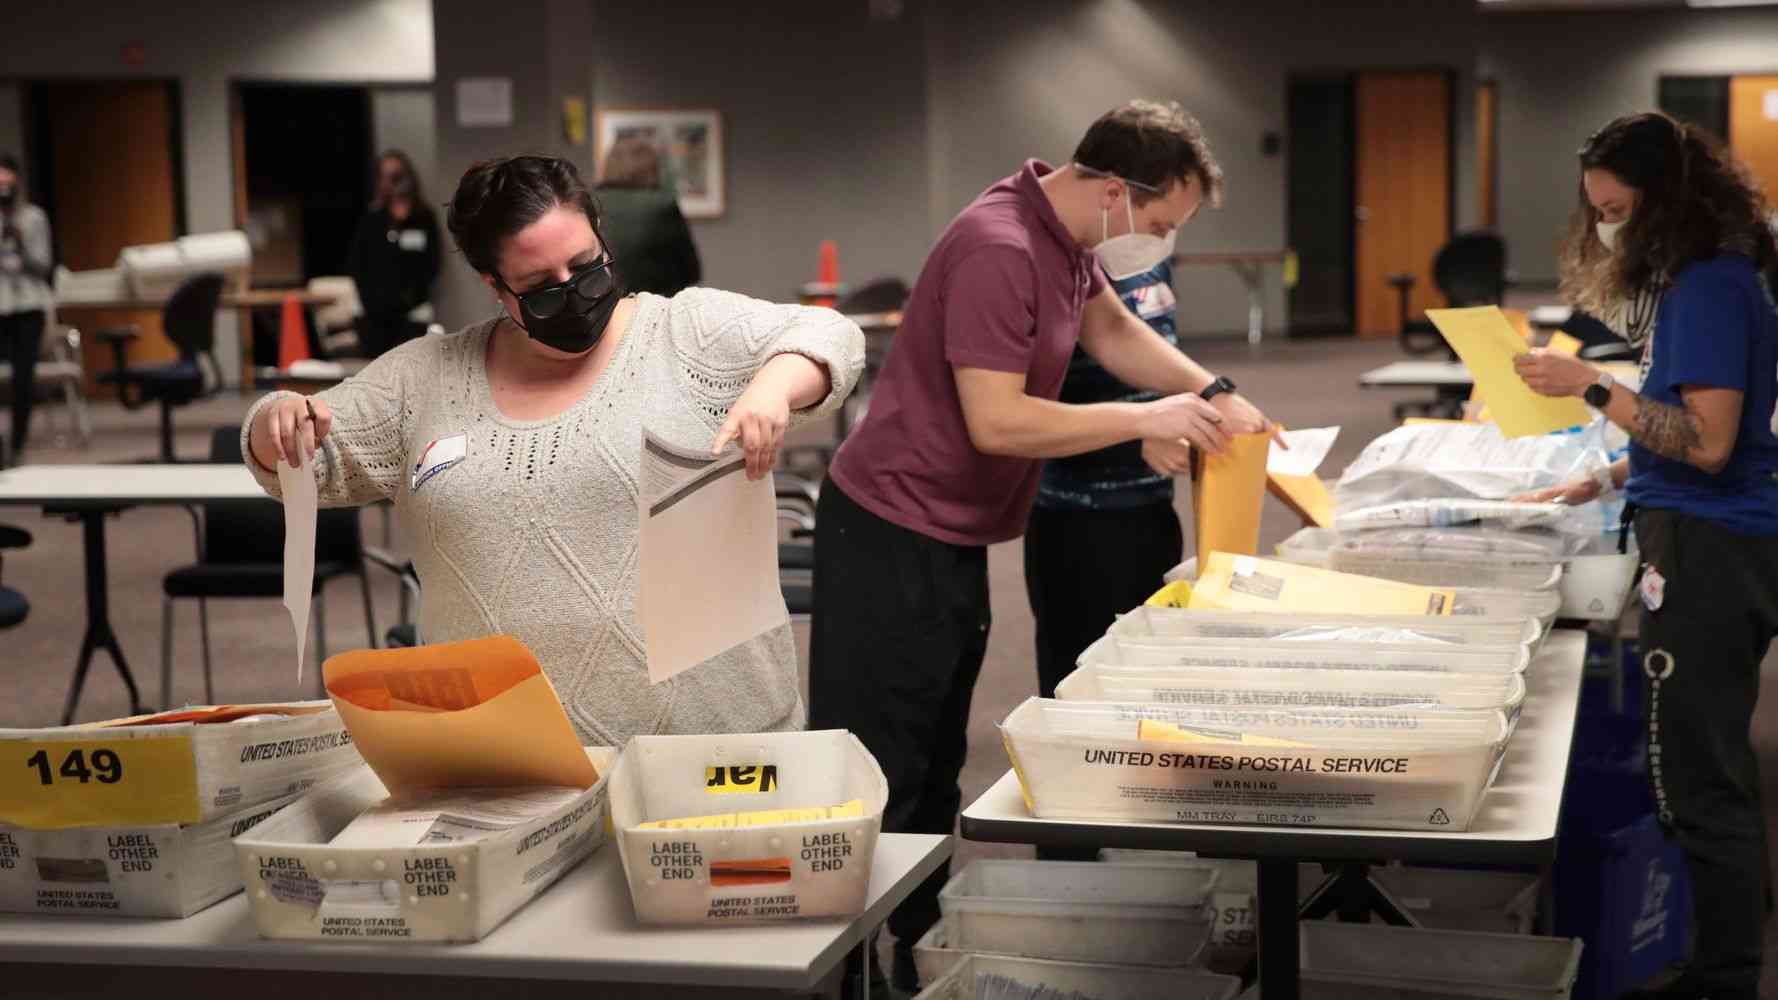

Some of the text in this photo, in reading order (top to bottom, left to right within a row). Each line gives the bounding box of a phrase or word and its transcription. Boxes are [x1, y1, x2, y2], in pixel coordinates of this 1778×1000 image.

[241, 743, 278, 763] UNITED
[276, 737, 310, 760] STATES
[27, 749, 122, 785] 149
[1085, 749, 1409, 774] UNITED STATES POSTAL SERVICE
[1213, 779, 1278, 791] WARNING
[1176, 811, 1200, 821] MM
[1202, 811, 1237, 822] TRAY
[107, 834, 154, 848] LABEL
[802, 832, 850, 848] LABEL
[109, 847, 159, 861] OTHER
[652, 841, 701, 855] LABEL
[801, 845, 852, 861] OTHER
[121, 860, 153, 873] END
[259, 856, 305, 871] LABEL
[404, 857, 454, 872] LABEL
[651, 855, 703, 868] OTHER
[811, 859, 844, 873] END
[404, 870, 457, 885] OTHER
[662, 867, 694, 880] END
[36, 890, 115, 900] UNITED STATES
[416, 884, 449, 897] END
[36, 899, 75, 909] POSTAL
[711, 895, 796, 908] UNITED STATES
[707, 904, 800, 919] POSTAL SERVICE
[323, 917, 406, 927] UNITED STATES
[321, 927, 411, 937] POSTAL SERVICE
